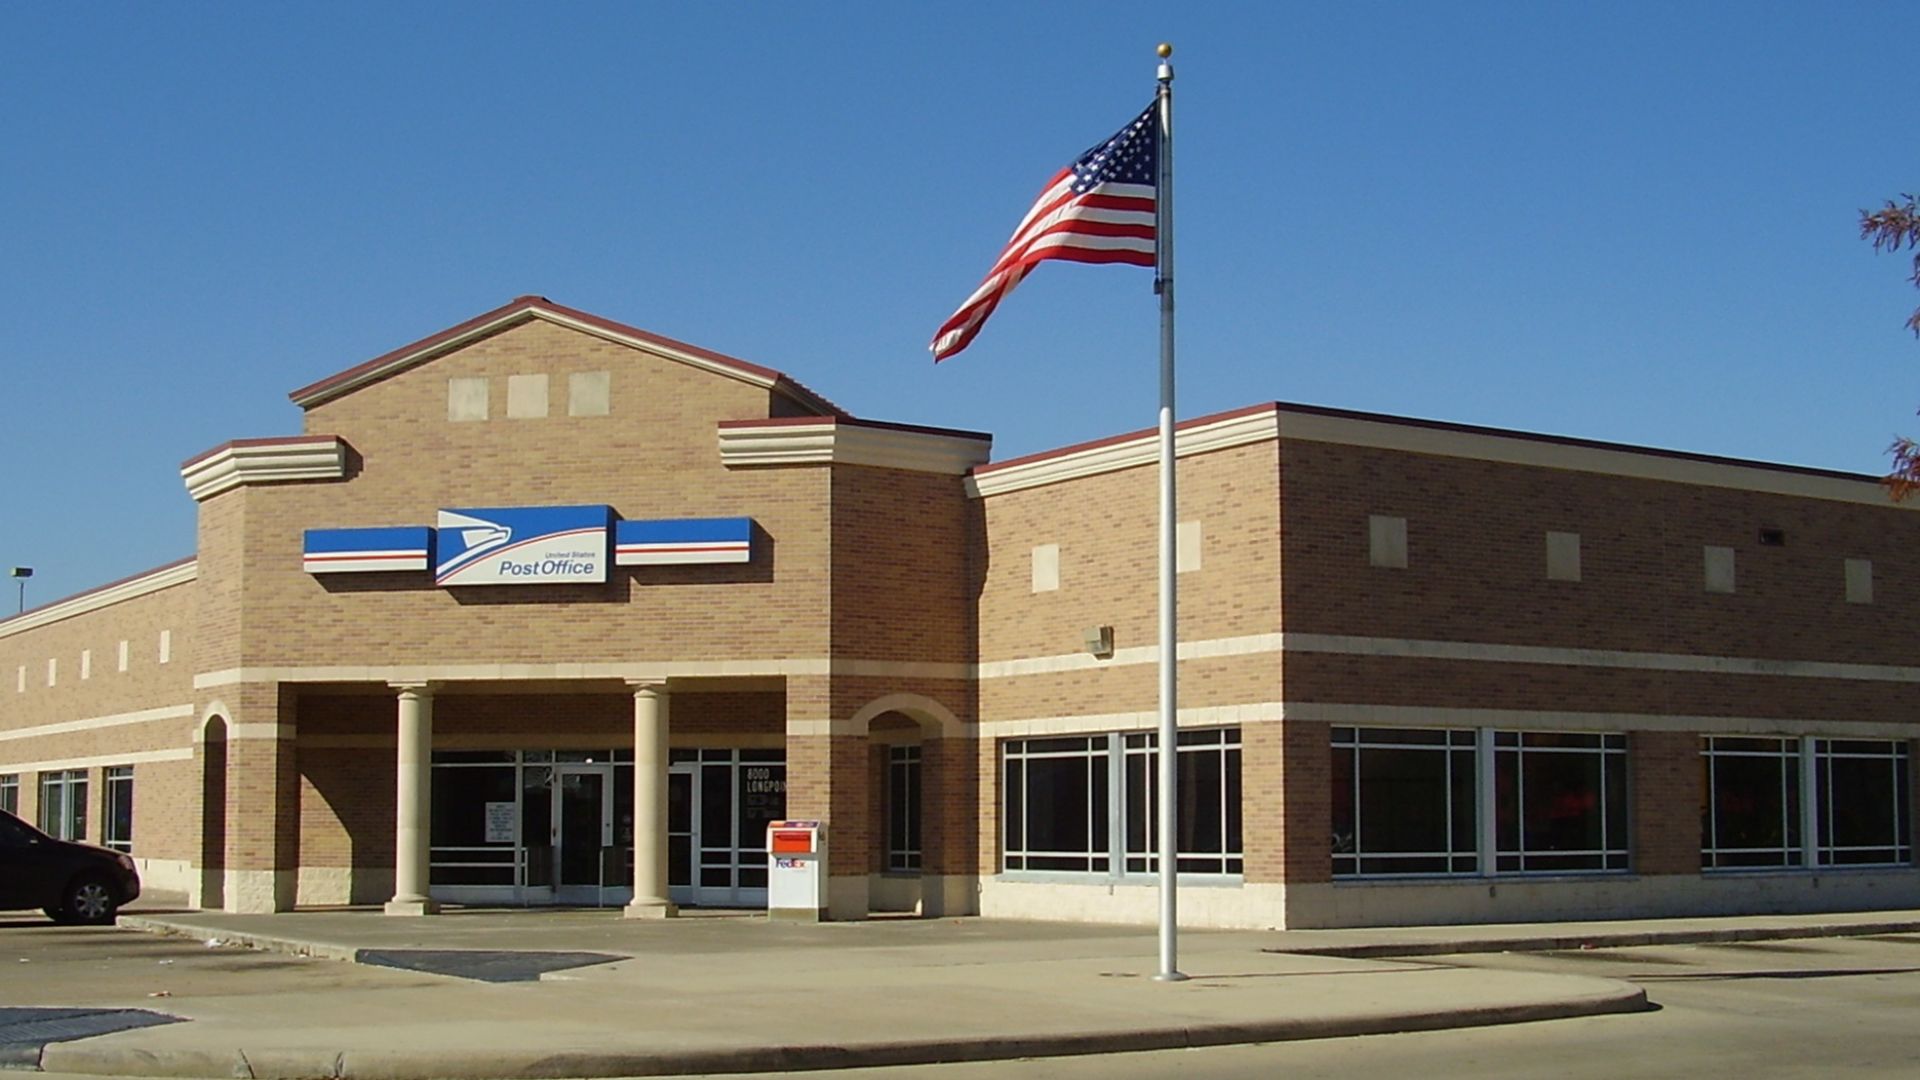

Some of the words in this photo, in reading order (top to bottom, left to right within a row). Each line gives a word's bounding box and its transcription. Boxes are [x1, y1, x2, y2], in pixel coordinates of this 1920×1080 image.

[499, 561, 539, 575] Post
[541, 560, 594, 574] Office
[776, 858, 805, 868] FedEx
